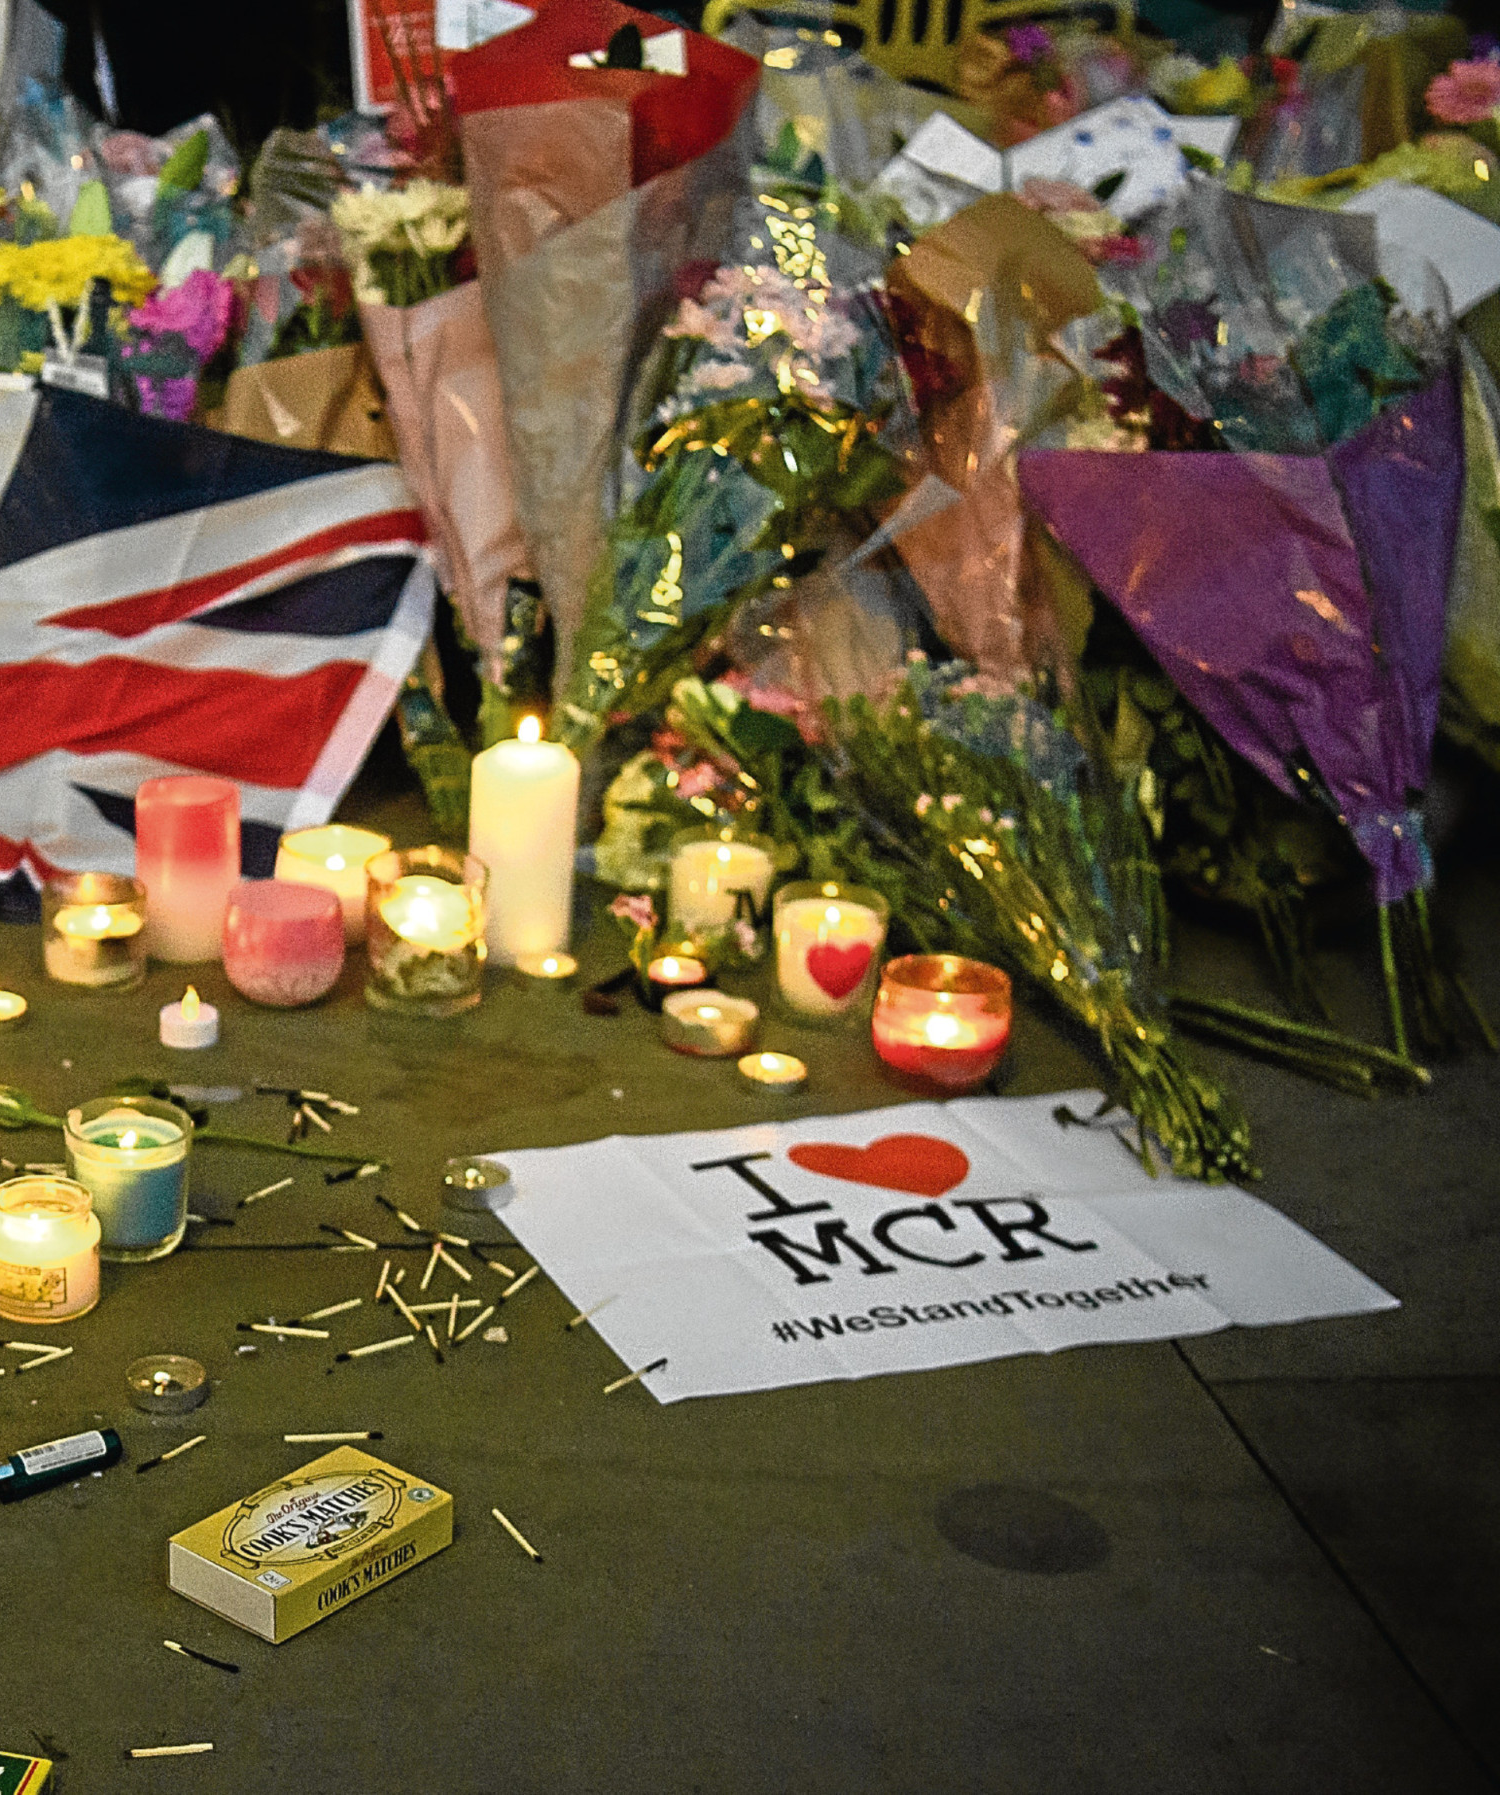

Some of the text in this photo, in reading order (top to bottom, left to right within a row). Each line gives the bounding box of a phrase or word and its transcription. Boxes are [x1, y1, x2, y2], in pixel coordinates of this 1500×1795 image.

[690, 1151, 832, 1221] I
[747, 1194, 1098, 1285] MCR
[772, 1271, 1210, 1342] #WeStandTogether
[240, 1518, 310, 1558] COOK'S
[300, 1478, 386, 1526] MATCHES
[362, 1540, 417, 1586] MATCHES
